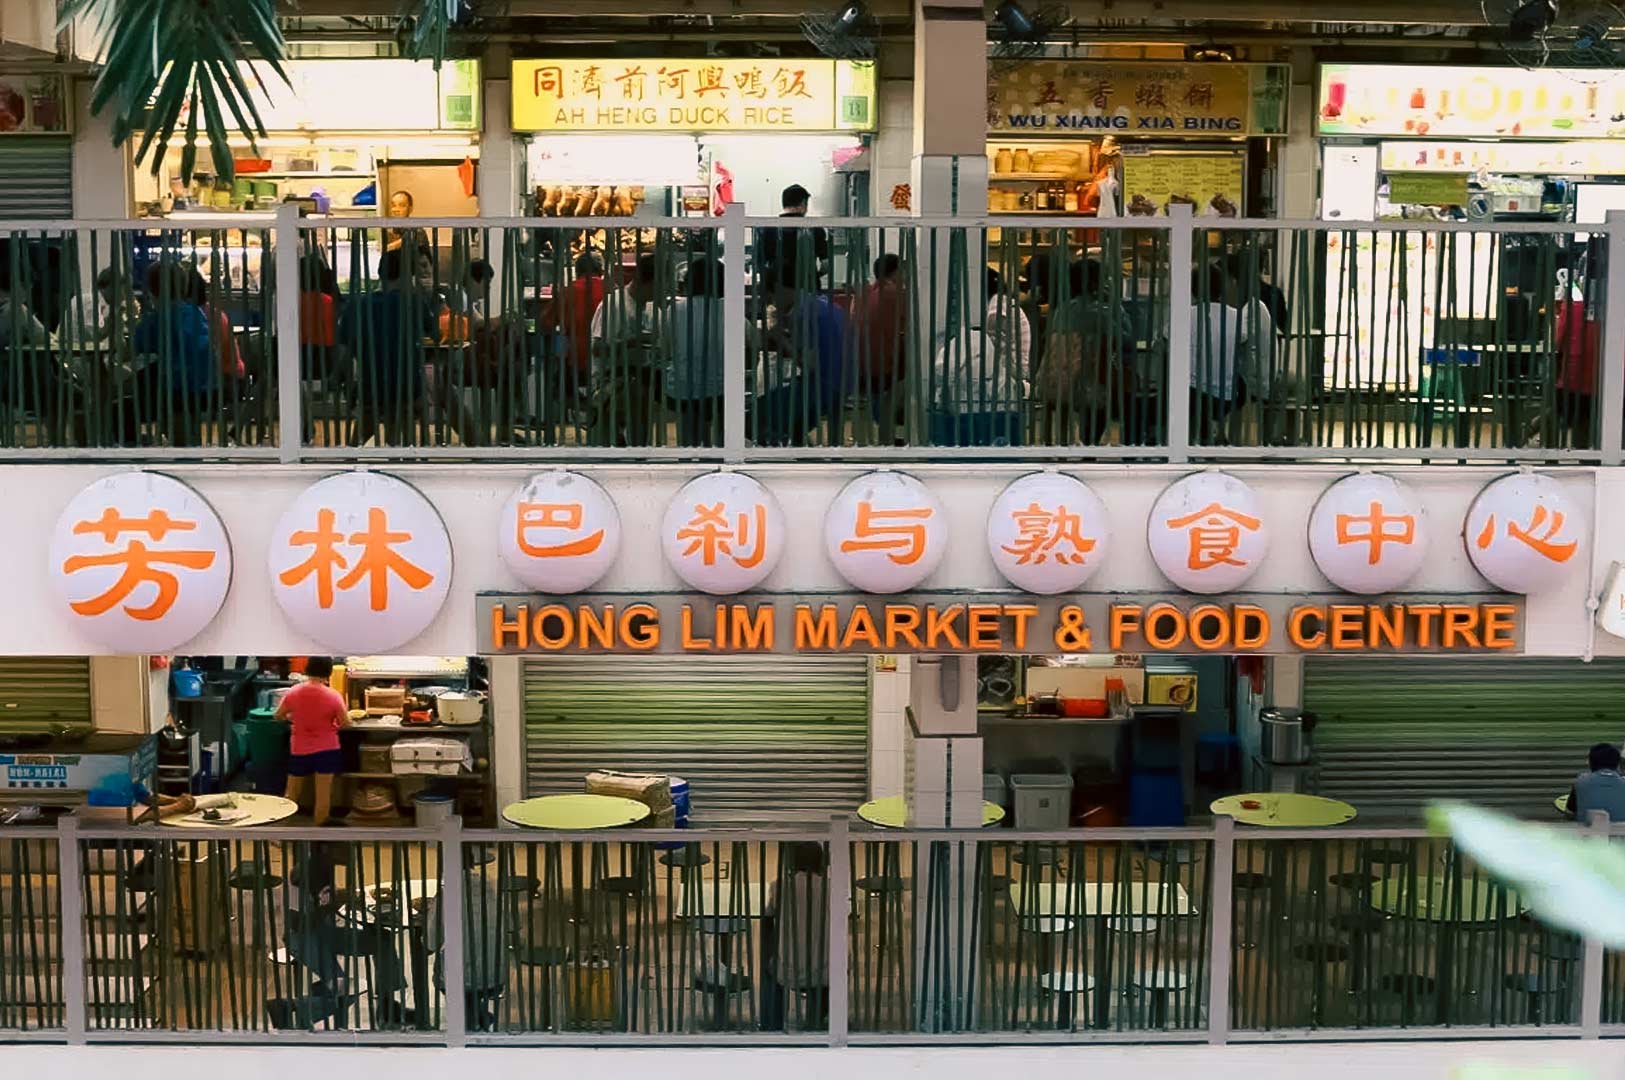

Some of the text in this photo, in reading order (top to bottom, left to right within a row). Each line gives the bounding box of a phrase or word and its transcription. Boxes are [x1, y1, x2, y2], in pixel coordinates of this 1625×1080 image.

[555, 107, 794, 125] AH HENG DUCK RICE
[1007, 114, 1242, 131] WU XIANG XIA BING
[491, 603, 1518, 652] HONG LIM MARKET & FOOD CENTRE
